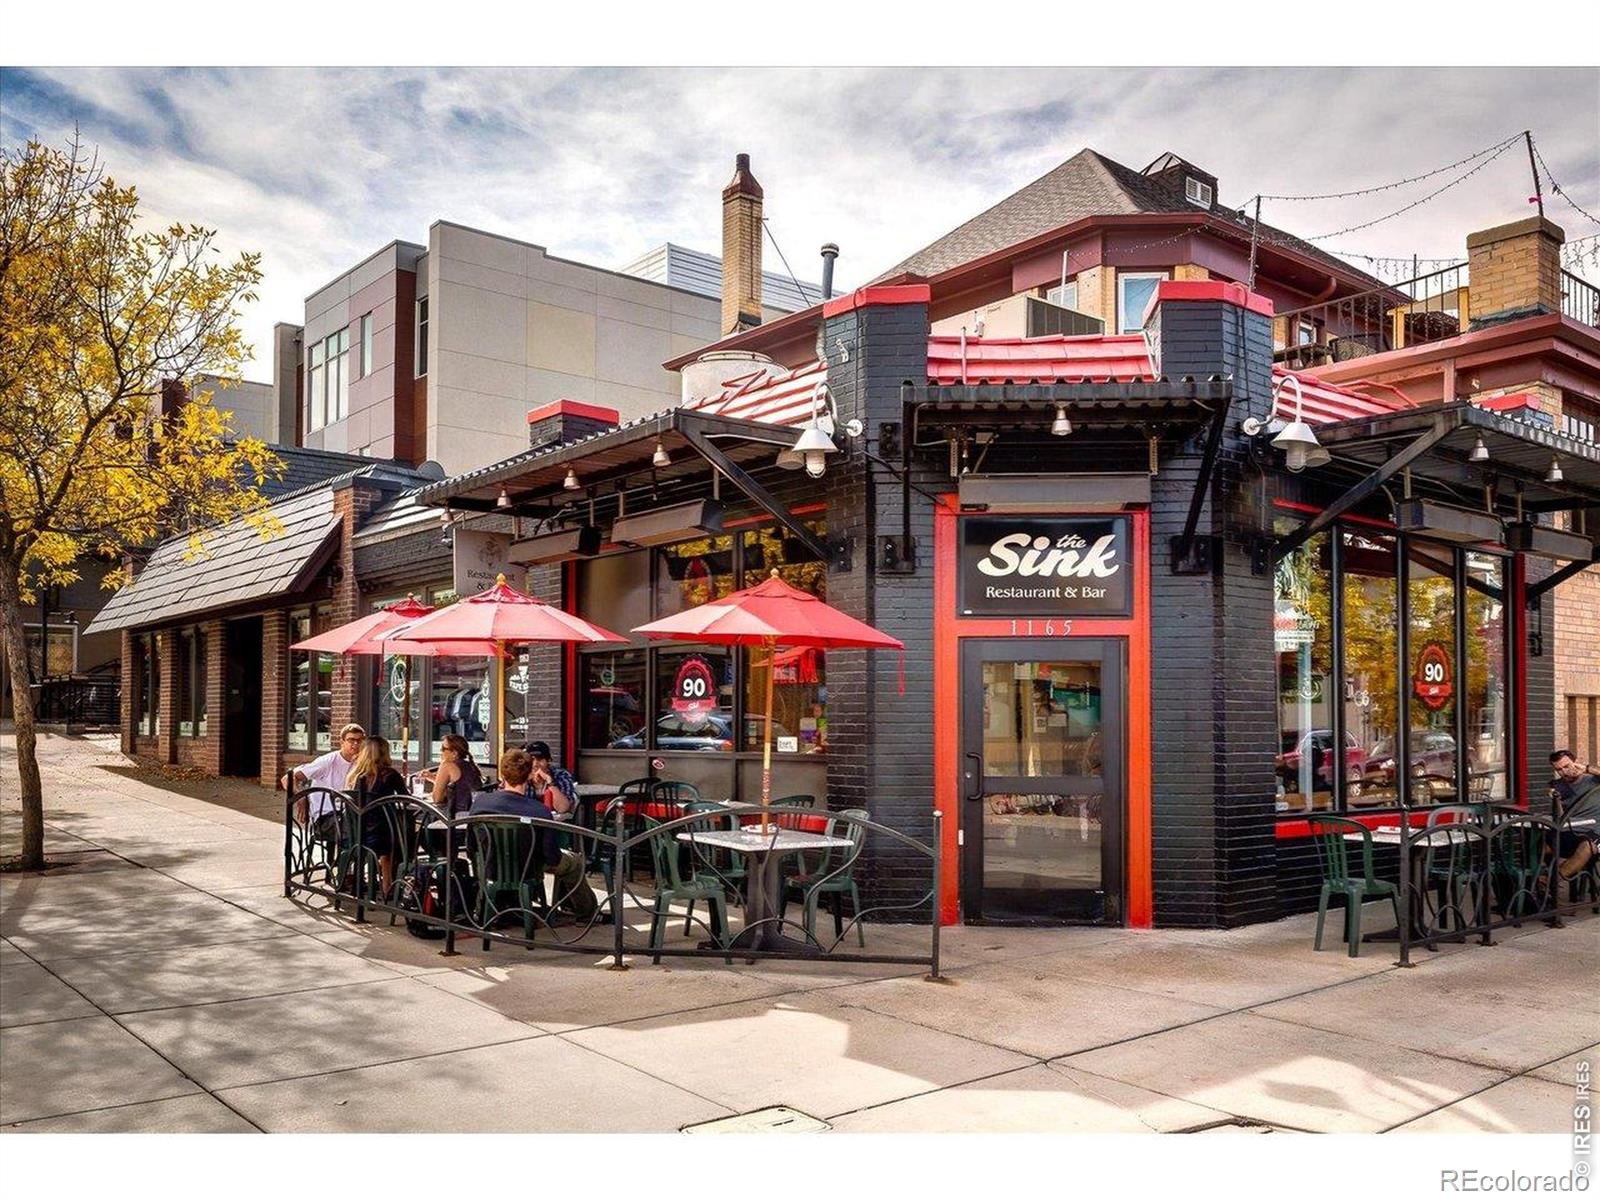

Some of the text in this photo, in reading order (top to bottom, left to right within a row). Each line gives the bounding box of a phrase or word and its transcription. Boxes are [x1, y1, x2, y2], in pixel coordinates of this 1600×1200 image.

[1056, 534, 1086, 549] the
[977, 533, 1119, 577] Sink
[986, 586, 1106, 598] Restaurant & Bar
[1010, 620, 1072, 636] 1165
[1424, 663, 1443, 682] 90
[683, 678, 706, 697] 90
